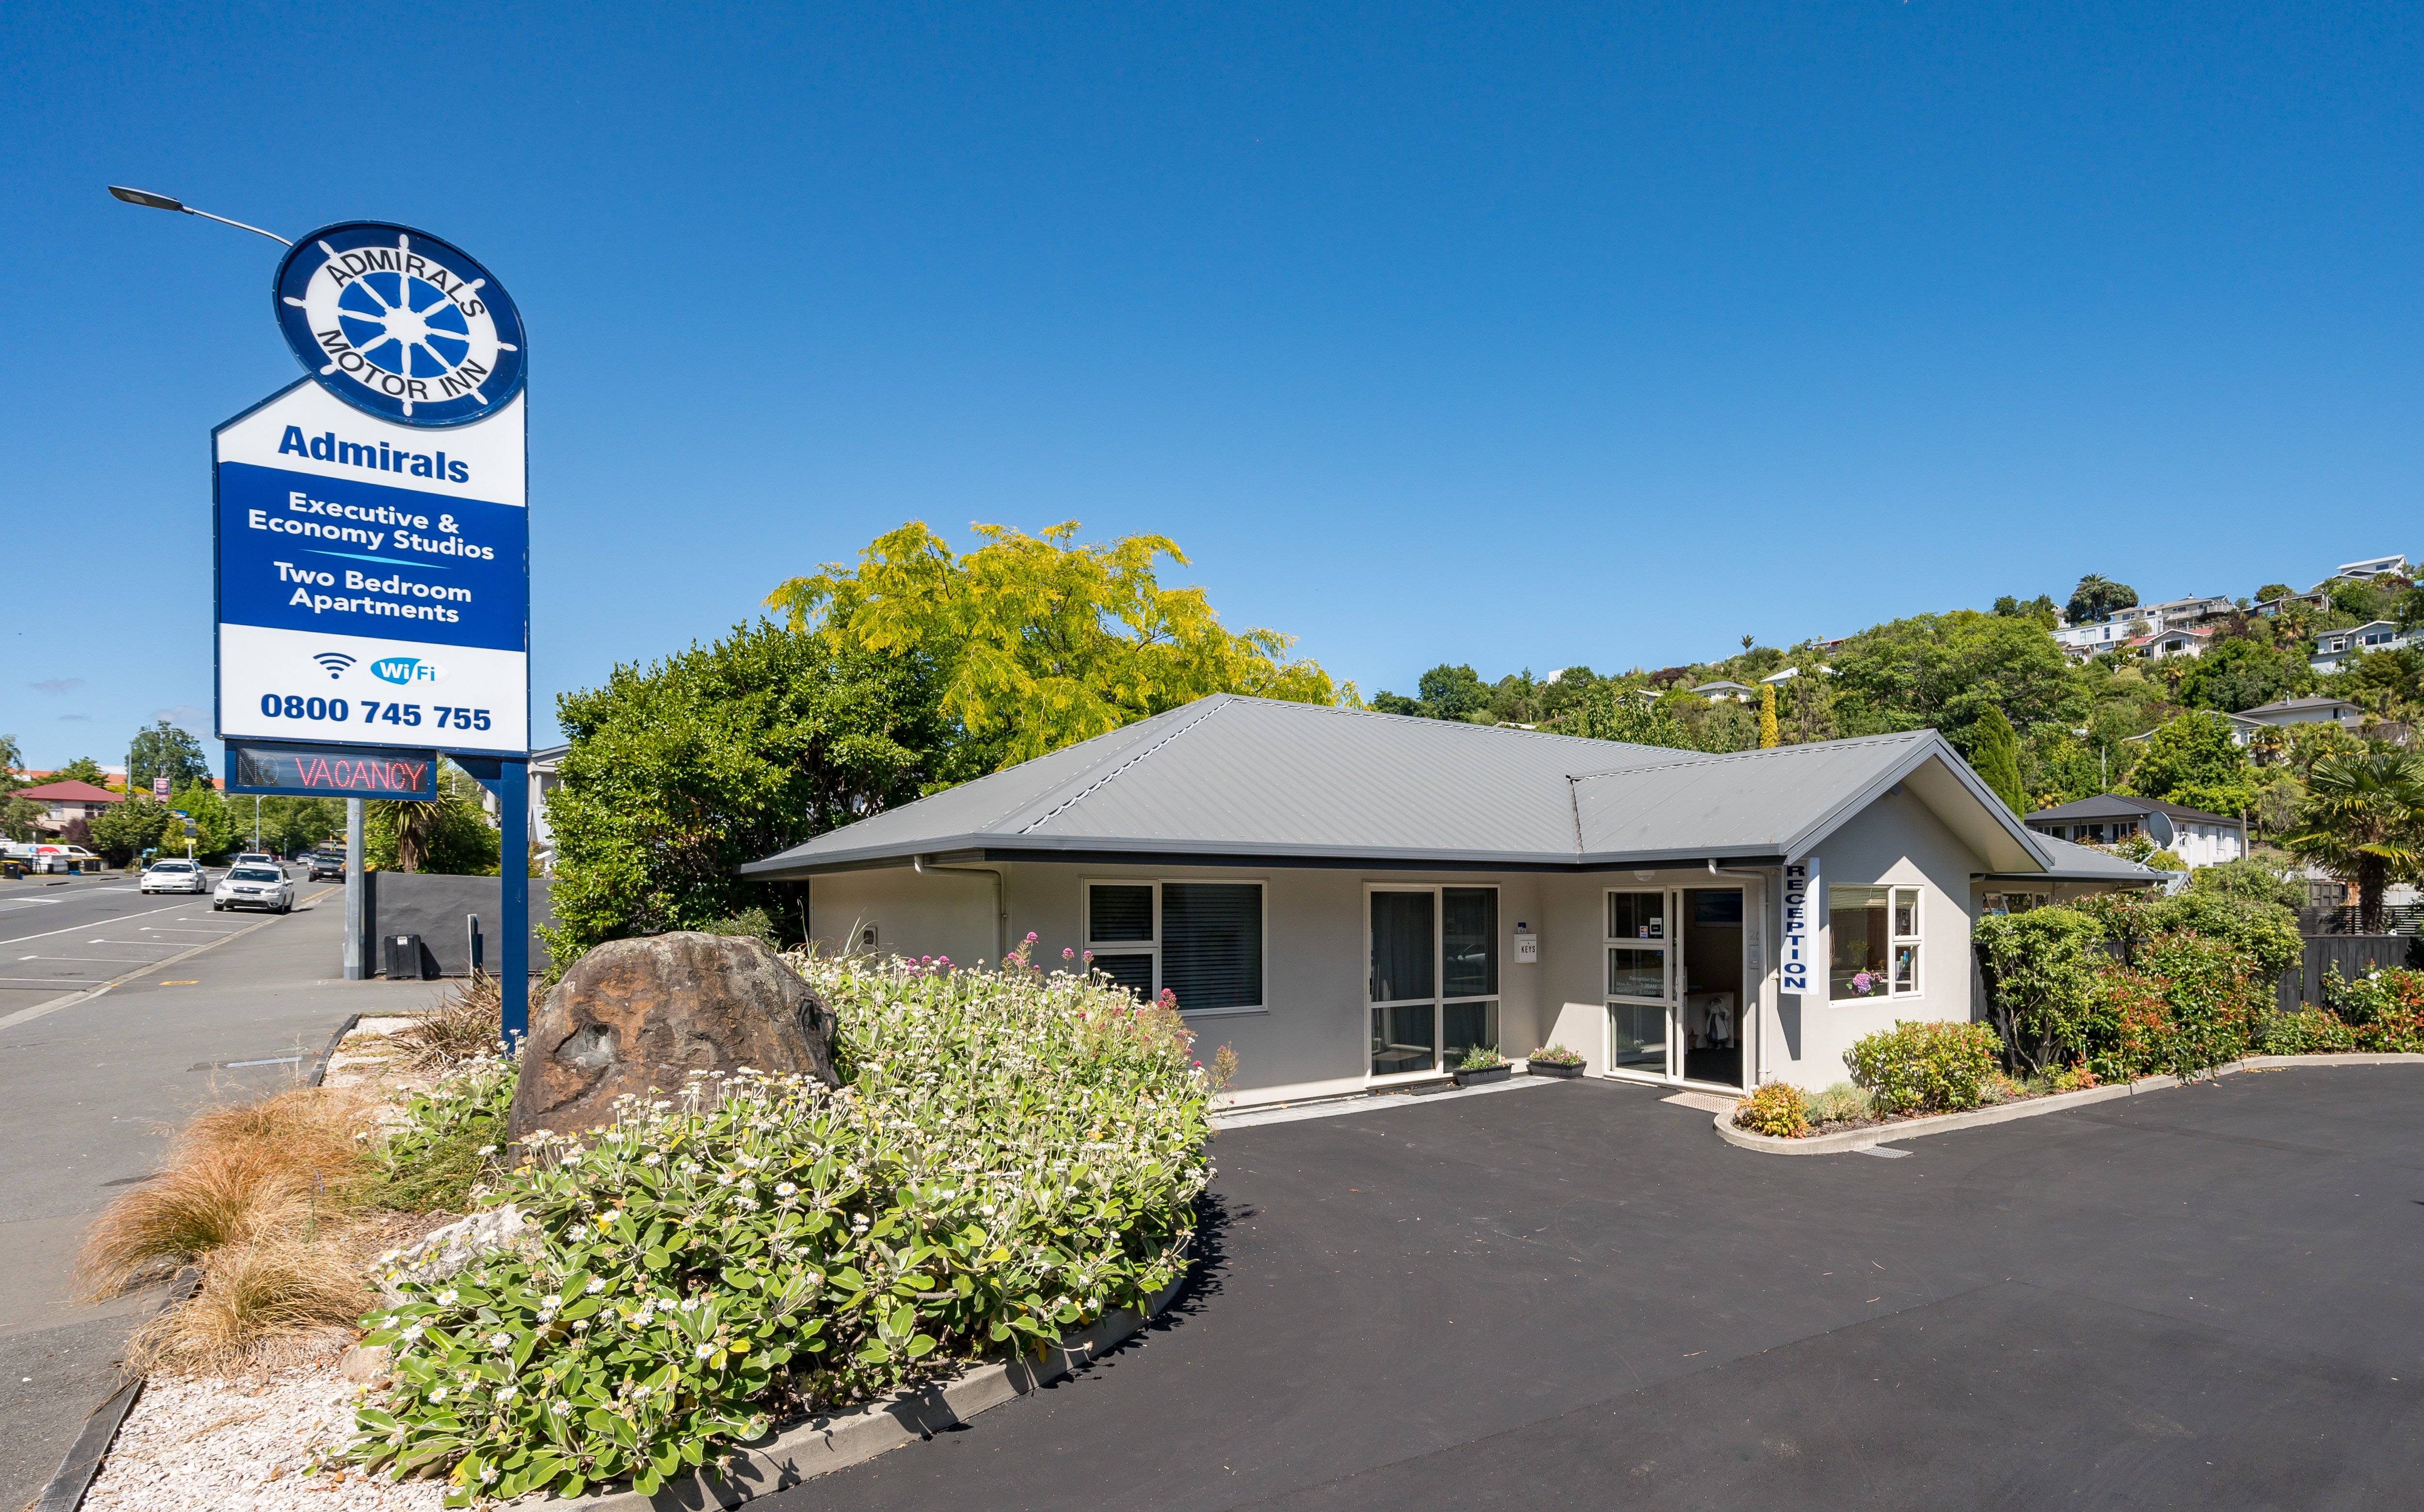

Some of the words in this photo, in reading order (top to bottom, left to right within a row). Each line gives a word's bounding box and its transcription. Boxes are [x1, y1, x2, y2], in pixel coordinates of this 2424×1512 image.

[325, 250, 485, 318] ADMIRALS
[317, 330, 429, 399] MOTOR
[439, 359, 488, 397] INN
[278, 425, 469, 483] Admirals
[249, 509, 384, 550] Economy
[393, 530, 494, 560] Studios
[289, 491, 429, 529] Executive
[438, 514, 460, 534] &
[273, 561, 335, 587] Two
[345, 570, 471, 603] Bedroom
[289, 587, 459, 623] Apartments
[261, 694, 349, 722] 0800
[361, 701, 421, 727] 745
[433, 706, 491, 731] 755
[239, 755, 279, 784] NO
[295, 757, 424, 791] VACANCY
[1785, 865, 1806, 988] RECEPTION
